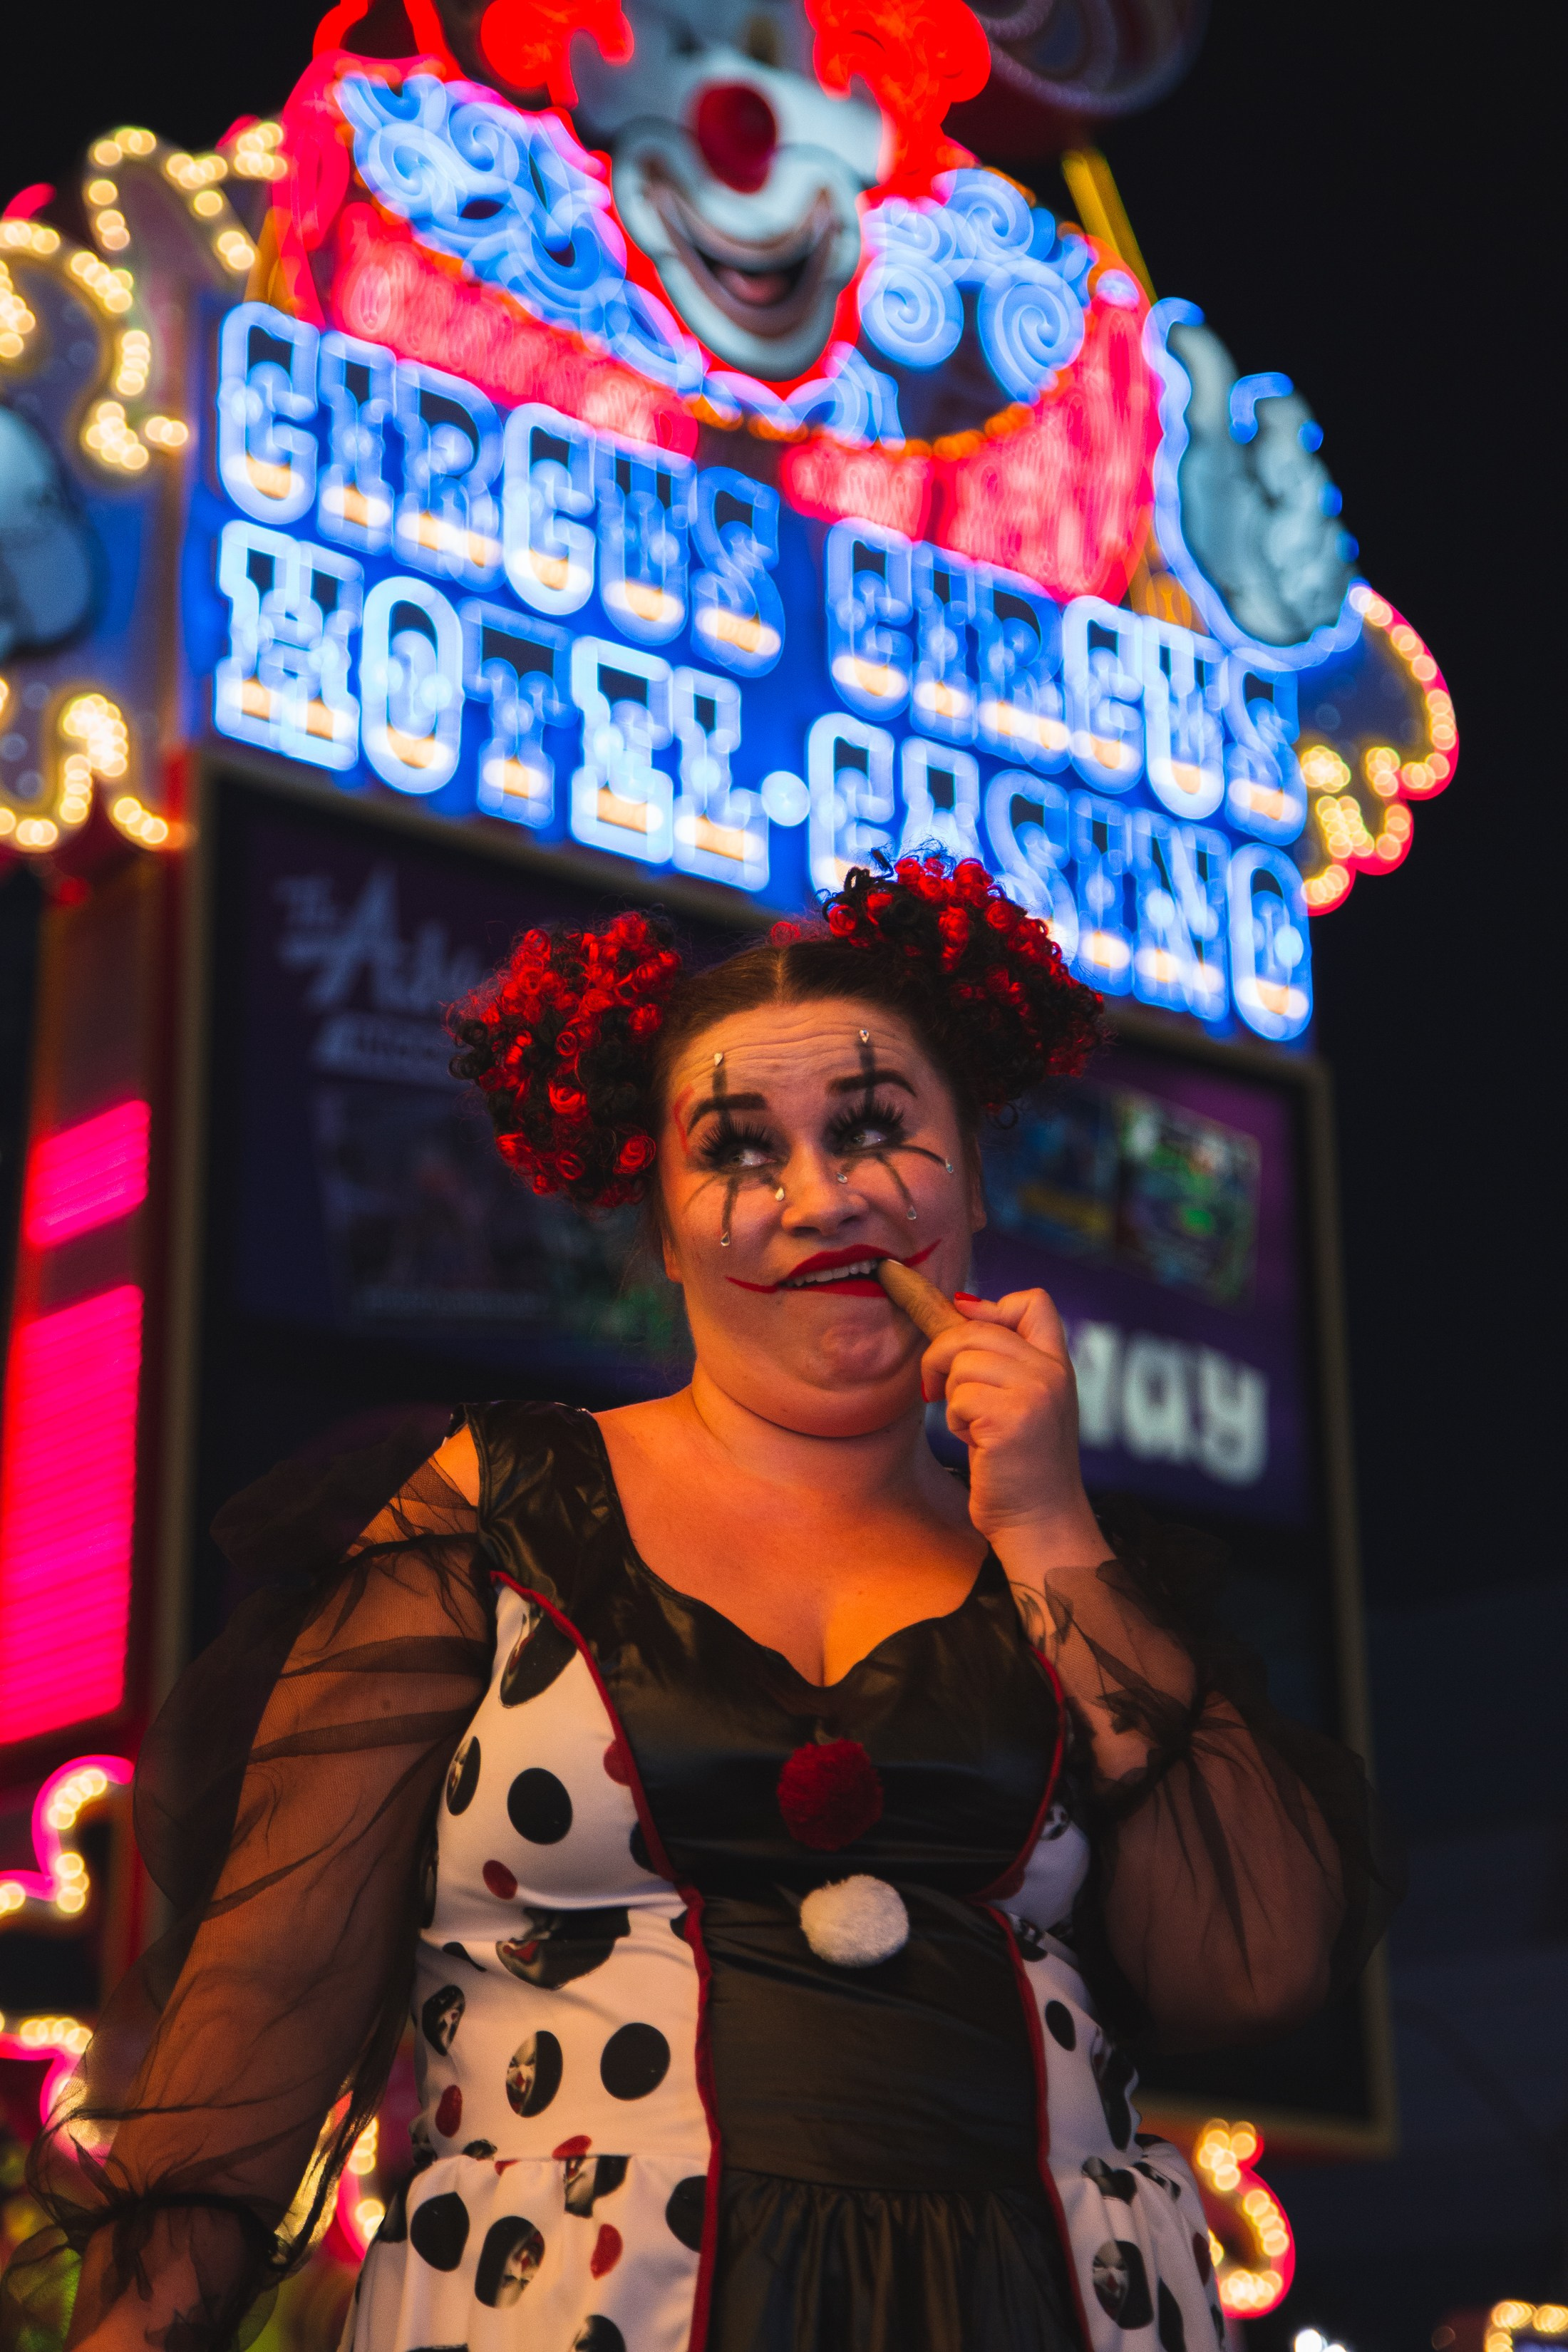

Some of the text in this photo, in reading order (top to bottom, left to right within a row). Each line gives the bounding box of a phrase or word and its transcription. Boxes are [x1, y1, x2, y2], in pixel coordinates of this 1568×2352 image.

[214, 520, 770, 891] HOTEL
[219, 301, 1307, 845] CIRCUS CIRCUS
